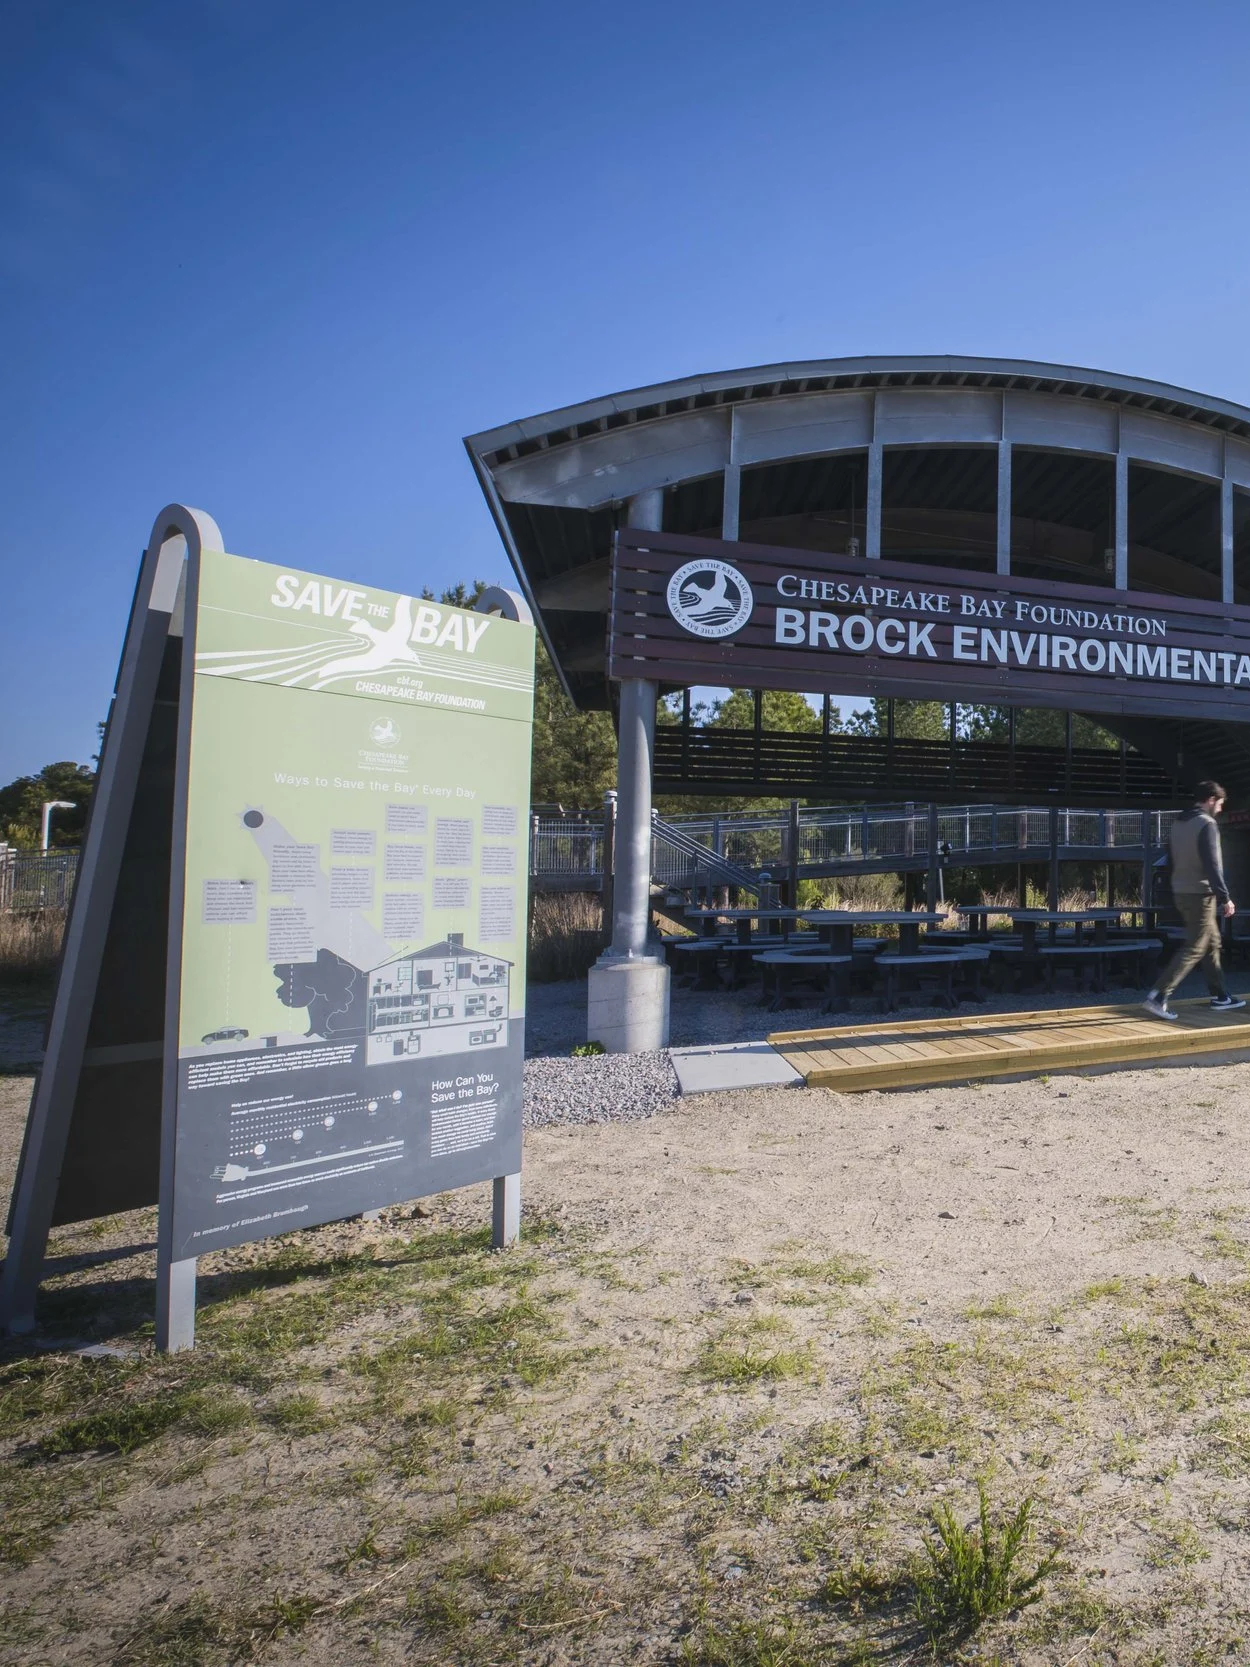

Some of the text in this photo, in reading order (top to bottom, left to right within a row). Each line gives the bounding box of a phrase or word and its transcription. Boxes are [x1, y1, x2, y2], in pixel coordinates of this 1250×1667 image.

[687, 562, 735, 576] SAVE THE BAY
[271, 574, 490, 653] SAVE THE BAY
[776, 574, 1167, 637] CHESAPEAKE BAY FOUNDATION
[775, 607, 938, 658] BROCK
[396, 675, 424, 688] cbf.org
[355, 681, 486, 711] CHESAPEAKE BAY FOUNDATION
[273, 772, 310, 787] Ways
[315, 776, 329, 787] to
[333, 777, 365, 790] Save
[369, 780, 390, 792] the
[422, 784, 453, 798] Every
[456, 787, 476, 799] Day
[431, 1073, 494, 1091] How Can You
[431, 1082, 500, 1104] Save the Bay?
[202, 1224, 231, 1235] memory
[231, 1220, 241, 1228] of
[241, 1213, 272, 1226] Elizabeth
